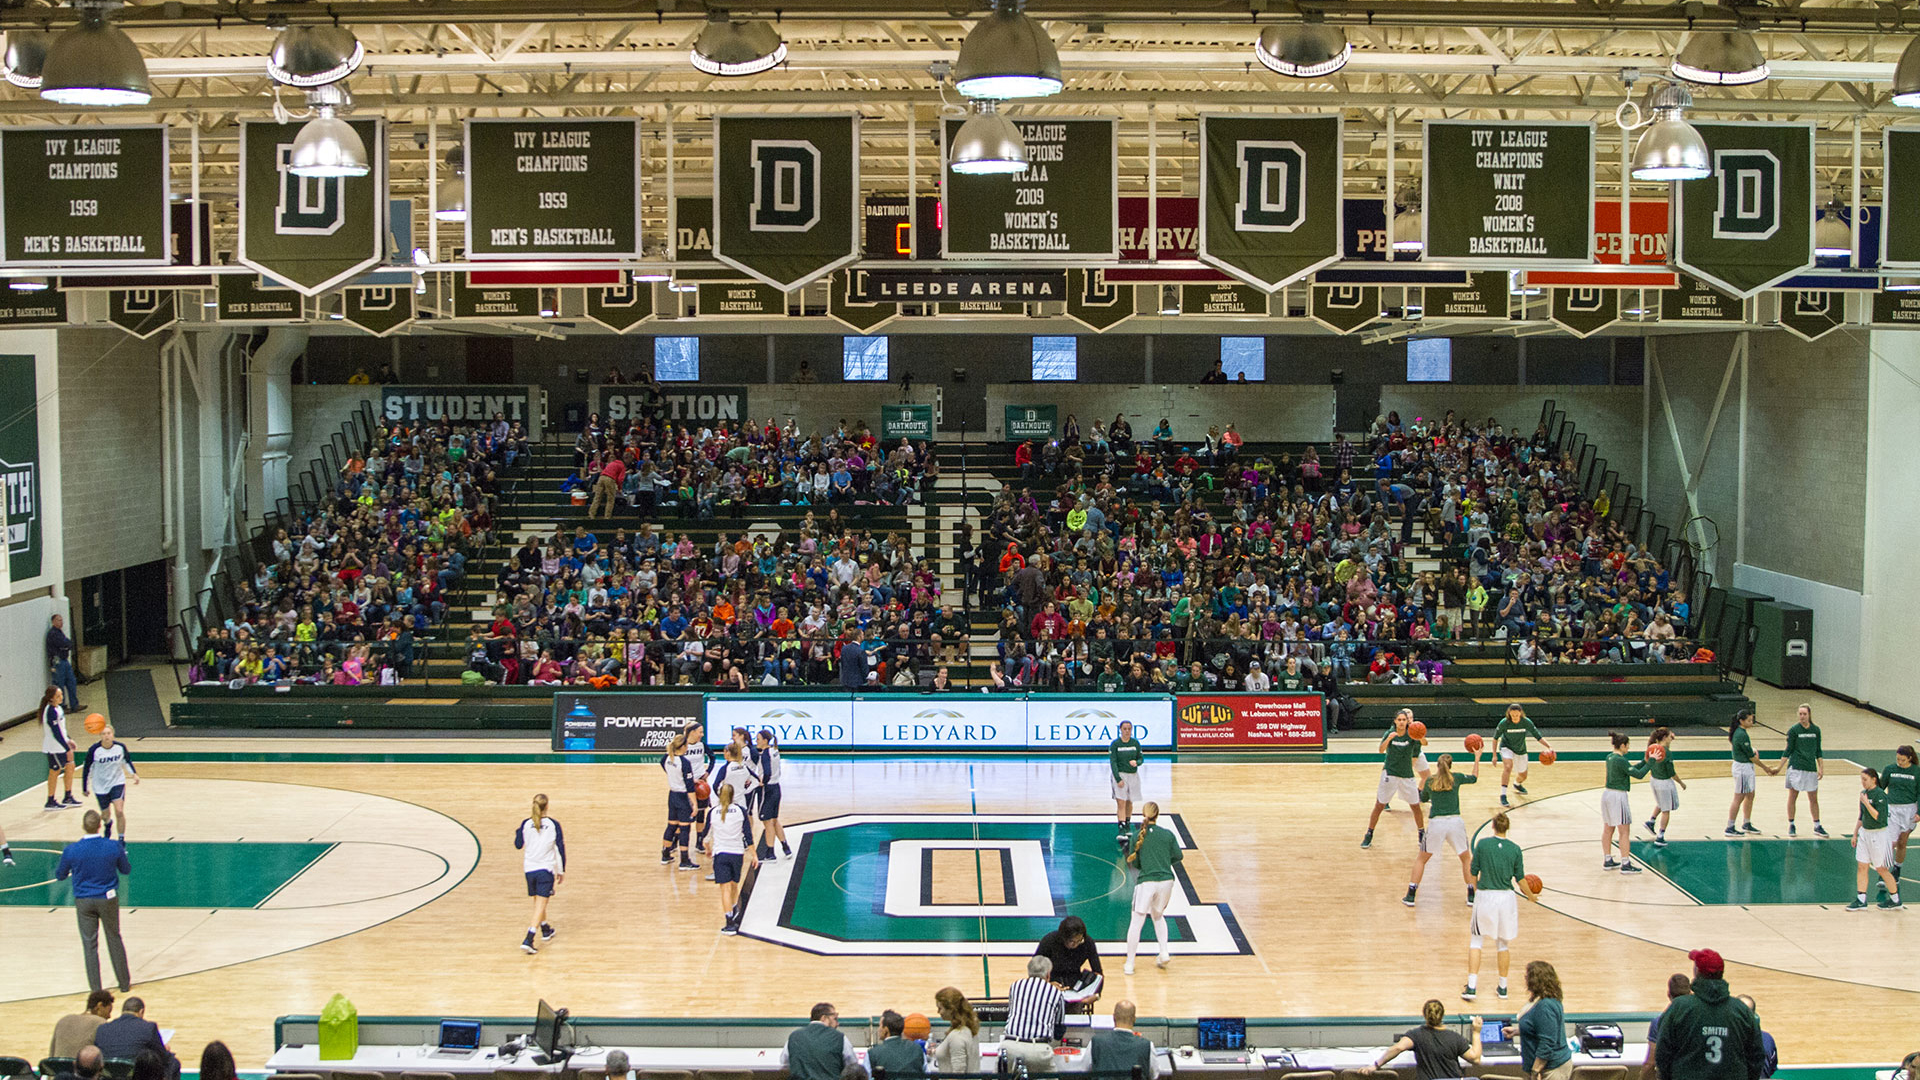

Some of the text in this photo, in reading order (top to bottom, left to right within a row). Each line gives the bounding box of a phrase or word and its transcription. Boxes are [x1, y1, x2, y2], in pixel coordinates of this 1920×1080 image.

[514, 132, 590, 148] IVY LEAGUE
[1020, 125, 1066, 142] LEAGUE
[1471, 130, 1548, 148] IVY LEAGUE
[46, 138, 121, 156] IVY LEAGUE
[1025, 145, 1064, 162] PIONS
[517, 156, 588, 172] CHAMPIONS
[1476, 151, 1543, 169] CHAMPIONS
[49, 162, 118, 180] CHAMPIONS
[1012, 165, 1048, 182] NCAA
[750, 140, 821, 232] D
[1235, 140, 1306, 232] D
[1493, 174, 1525, 190] WNIT
[538, 192, 568, 209] 1959
[1016, 188, 1044, 205] 2009
[1713, 149, 1780, 240] D
[70, 200, 98, 216] 1958
[866, 205, 910, 216] DARTMOUT
[1495, 194, 1523, 212] 2008
[1004, 210, 1058, 229] WOMEN'S
[1482, 214, 1534, 232] WOMEN'S
[24, 235, 146, 252] MEN'S BASKETBALL
[491, 228, 615, 246] MEN'S BASKETBALL
[990, 234, 1070, 250] BASKETBALL
[1119, 227, 1198, 250] HARVA
[1594, 233, 1668, 255] CETON
[1470, 237, 1547, 254] BASKETBALL
[482, 291, 510, 301] WOMEN'S
[728, 289, 756, 299] WOMEN'S
[881, 283, 1052, 296] LEEDE ARENA
[1210, 292, 1238, 302] WOMEN'S
[1452, 291, 1480, 301] WOMEN'S
[0, 308, 14, 318] EN'S
[250, 302, 293, 312] BASKETBALL
[475, 303, 518, 312] BASKETBALL
[720, 301, 763, 311] BASKETBALL
[960, 302, 1002, 310] BASKETBALL
[1204, 303, 1245, 312] BASKETBALL
[1445, 304, 1487, 314] BASKETBALL
[1682, 308, 1722, 316] BASKETBALL
[1892, 310, 1920, 320] BASKETB
[385, 396, 738, 420] STUDENT SETION
[883, 724, 996, 740] LEDYARD
[1035, 724, 1149, 740] LEDYAD
[1280, 723, 1306, 731] Highway
[640, 739, 672, 747] HYDRA
[99, 754, 121, 764] UNH
[1702, 1026, 1728, 1036] SMITH
[1705, 1036, 1722, 1064] 3
